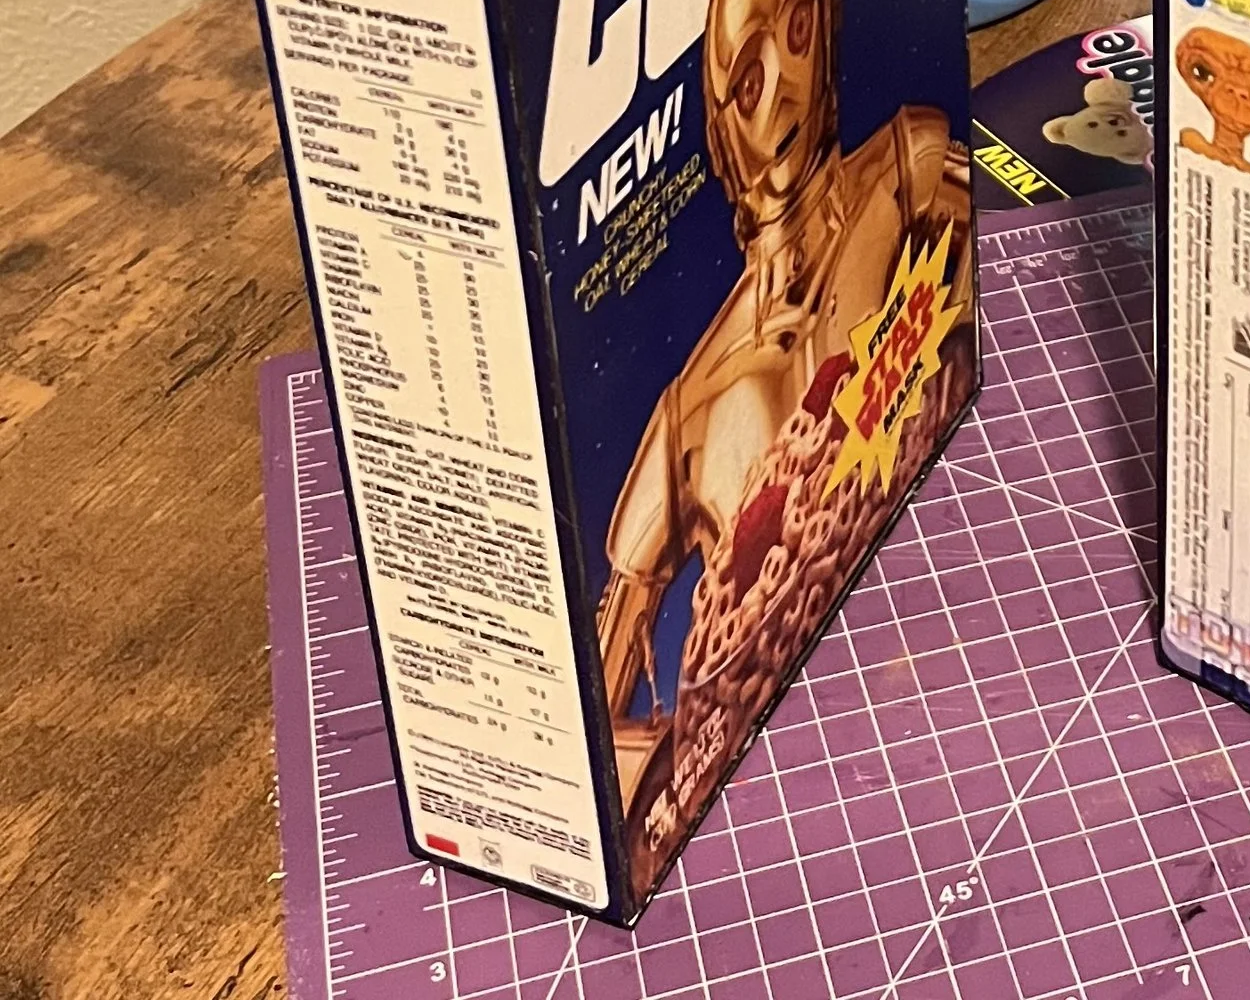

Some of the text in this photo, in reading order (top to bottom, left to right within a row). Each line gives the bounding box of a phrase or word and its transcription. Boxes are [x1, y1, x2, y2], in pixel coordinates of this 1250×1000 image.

[579, 80, 683, 246] NEW!
[669, 165, 706, 220] CORN
[974, 145, 1047, 196] NEW
[602, 163, 667, 248] CRUNCHY
[619, 229, 669, 299] CEREAL
[863, 278, 935, 400] STAR
[868, 283, 906, 360] FREE
[855, 302, 932, 440] WARS
[883, 352, 923, 434] MASK
[419, 868, 437, 887] 4
[937, 875, 979, 905] 45°
[429, 961, 447, 982] 3
[1175, 963, 1192, 986] 7
